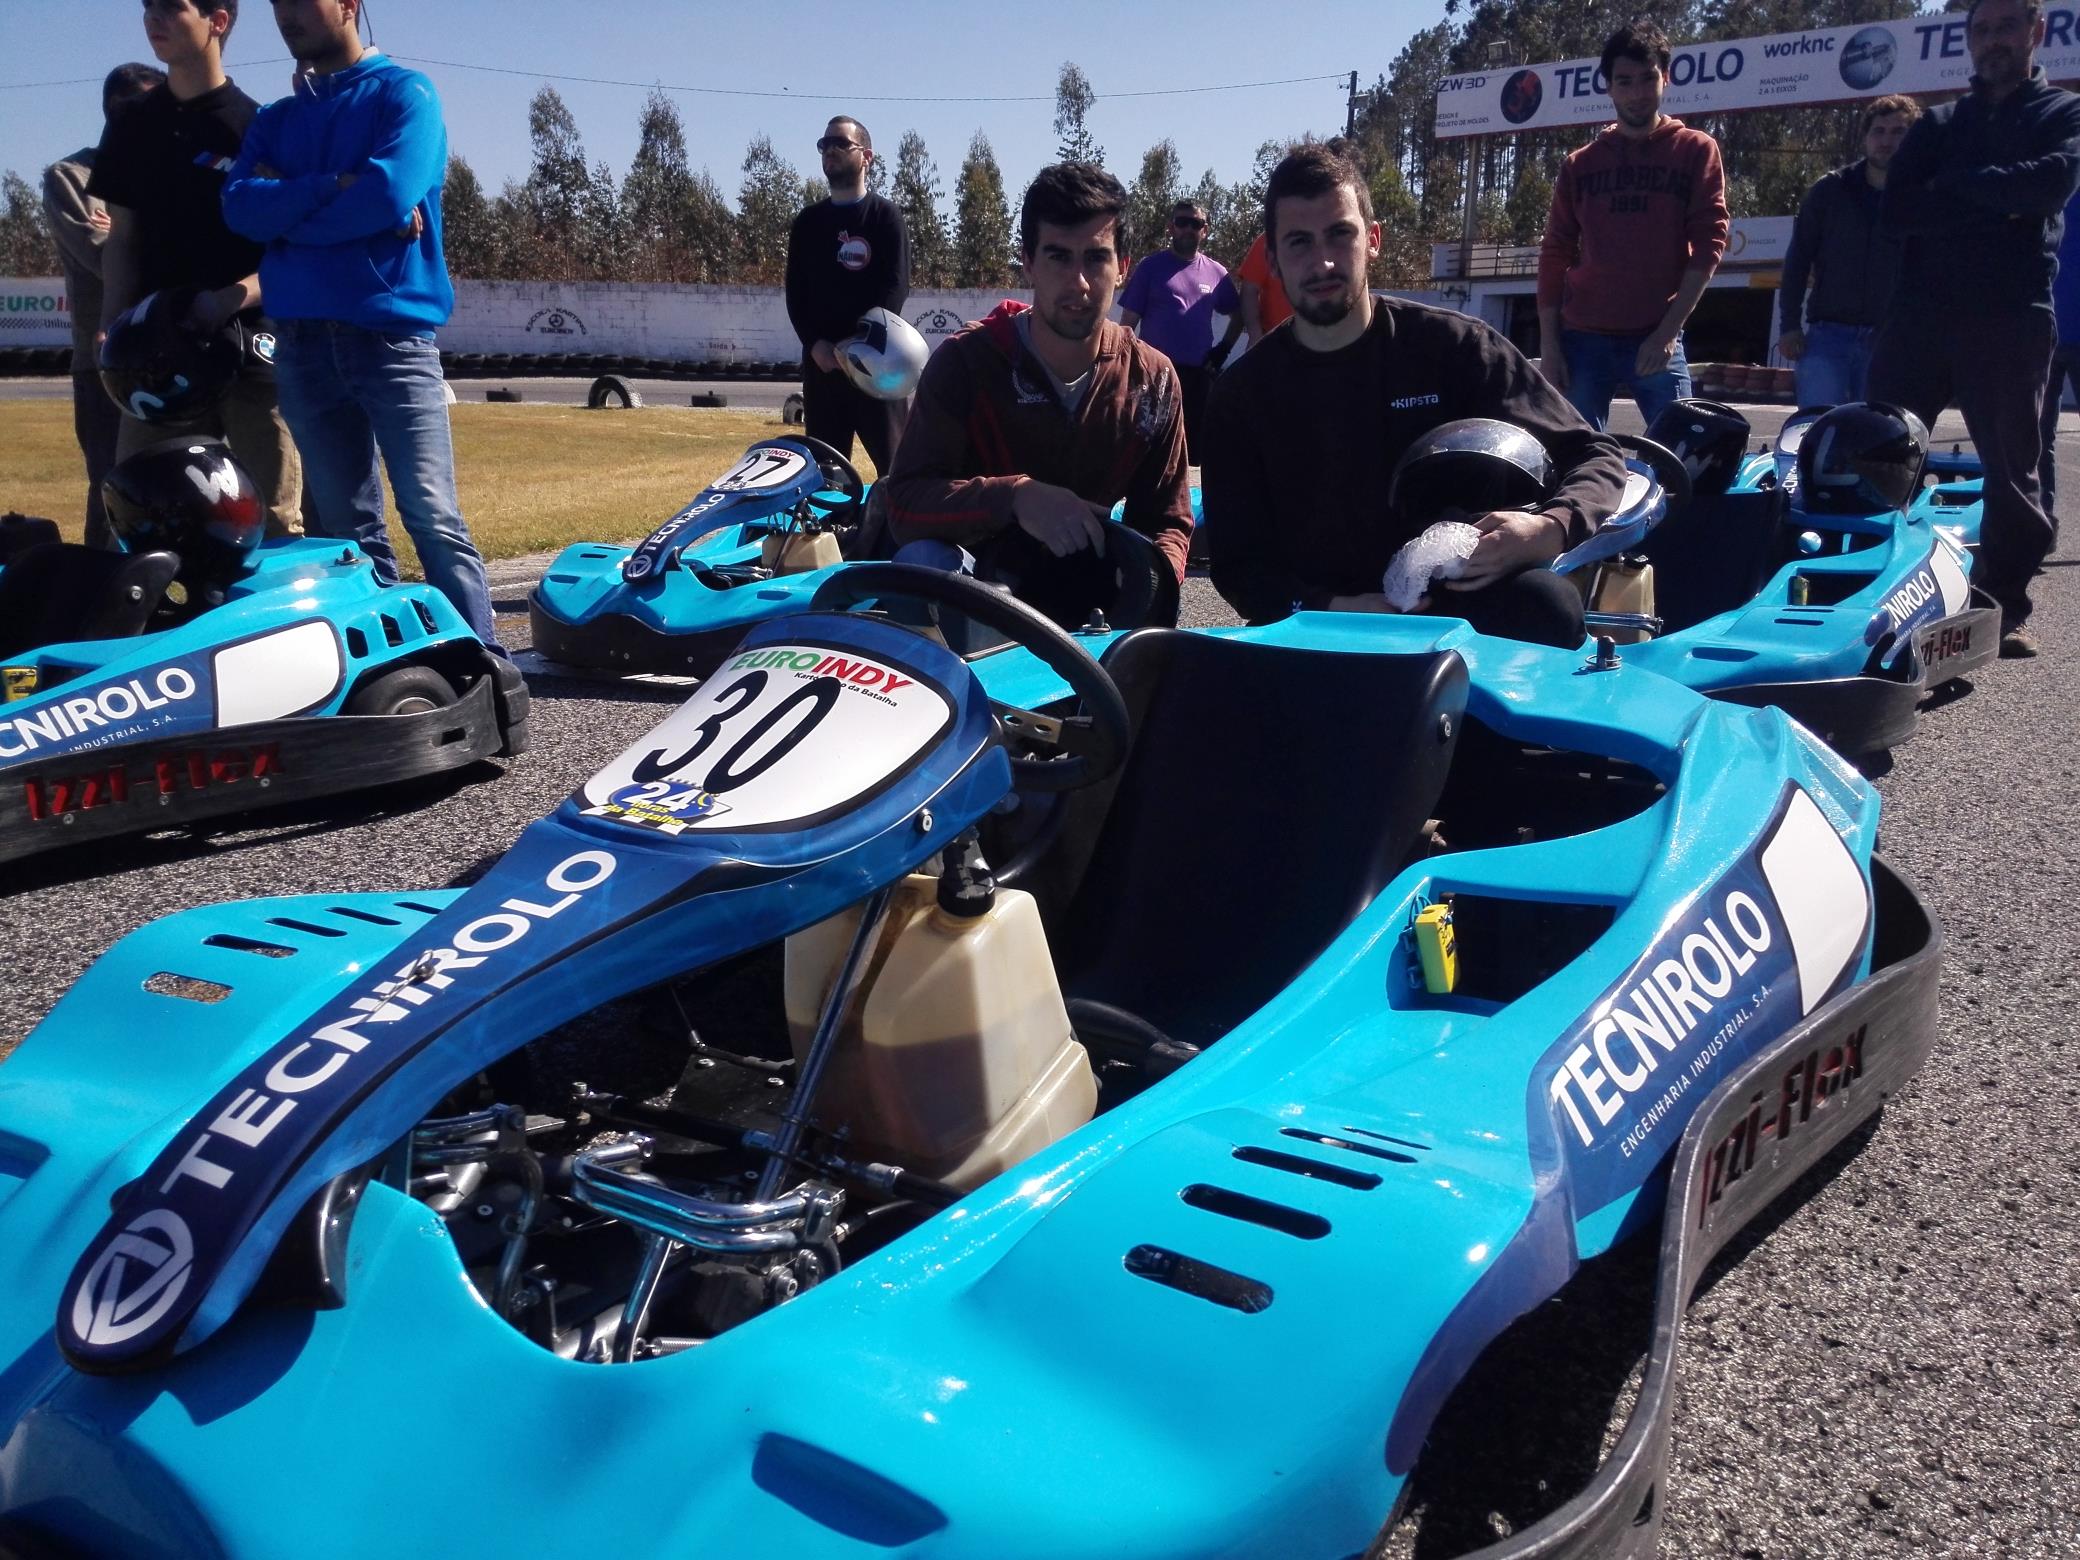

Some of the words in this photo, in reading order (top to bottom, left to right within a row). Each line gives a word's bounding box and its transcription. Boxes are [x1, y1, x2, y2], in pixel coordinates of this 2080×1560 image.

[1763, 35, 1835, 58] worknc
[1554, 48, 1744, 99] TECOLO
[1573, 104, 1615, 114] ENGENHA
[726, 453, 791, 482] 27
[728, 650, 913, 694] EUROINDY
[847, 683, 861, 693] da
[858, 688, 898, 708] Batalha
[632, 670, 841, 793] 30
[620, 781, 702, 812] 24
[159, 849, 618, 1189] TECNIROLO
[1550, 890, 1772, 1147] TECNIROLO
[1621, 1075, 1691, 1158] ENGENHARIA
[1752, 983, 1773, 1009] S.A.
